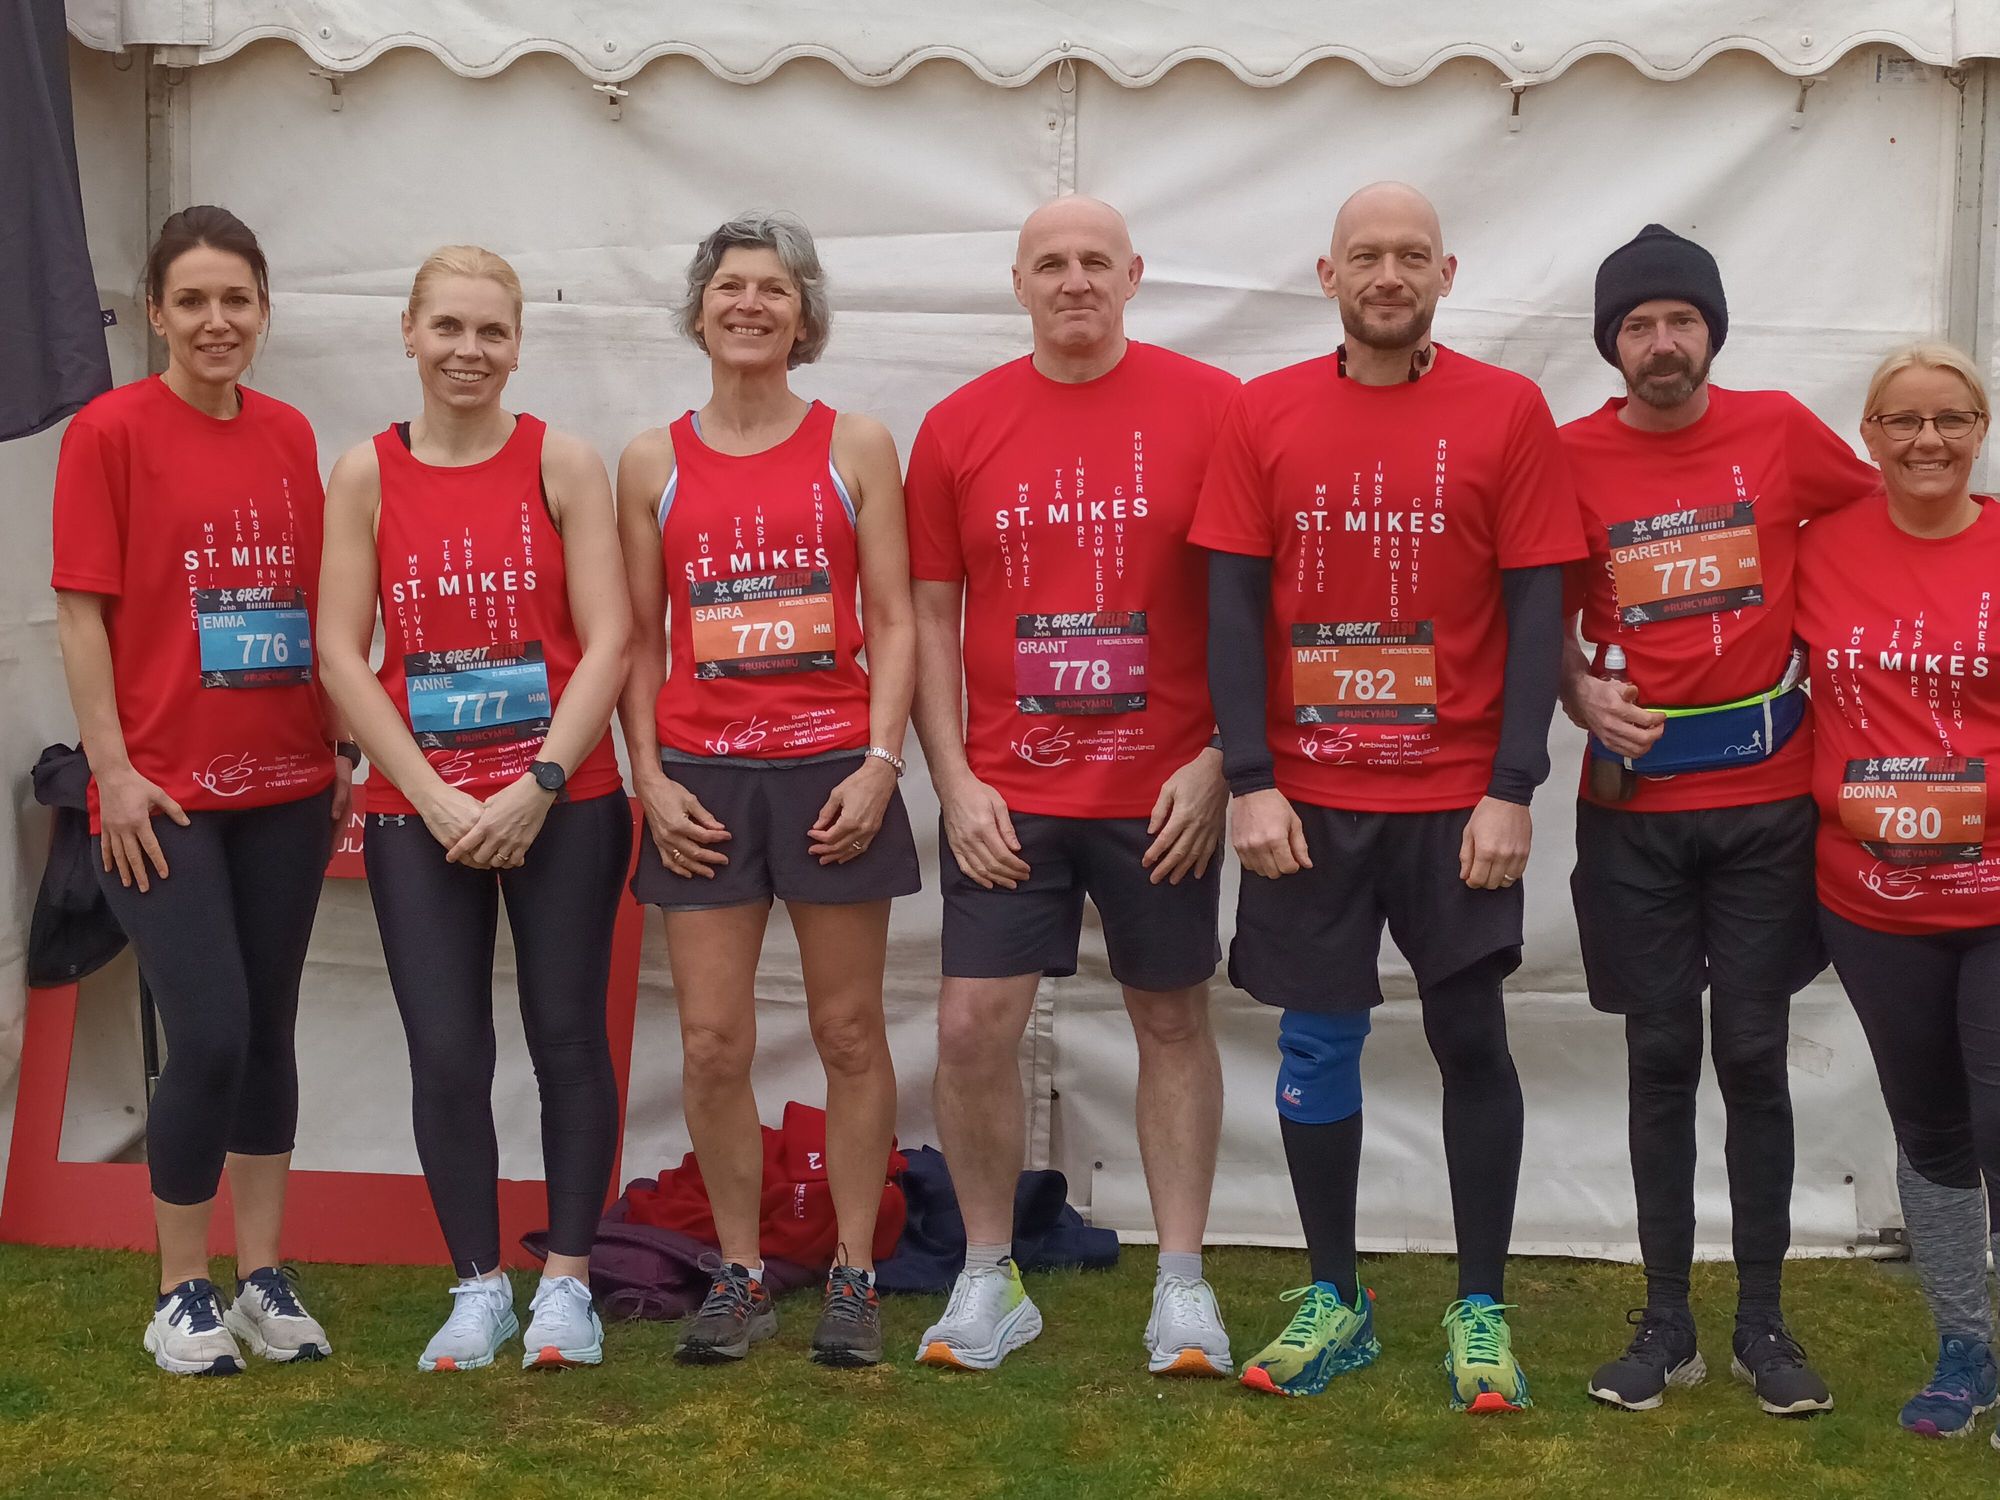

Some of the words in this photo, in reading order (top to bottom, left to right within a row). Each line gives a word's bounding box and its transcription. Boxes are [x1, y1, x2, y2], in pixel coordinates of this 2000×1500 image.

[995, 506, 1034, 531] ST.
[1048, 497, 1149, 525] MIKES
[1295, 511, 1332, 532] ST.
[1345, 511, 1447, 534] MIKES
[1651, 508, 1698, 530] GREAT
[184, 548, 220, 571] ST.
[1615, 540, 1682, 564] GARETH
[685, 557, 717, 582] ST.
[730, 547, 830, 574] MIKES
[1387, 511, 1404, 621] KNOWLEDG
[1738, 556, 1757, 570] HM
[1653, 554, 1721, 595] 775
[392, 579, 426, 603] ST.
[438, 570, 537, 596] MIKES
[732, 575, 778, 594] GREAT
[236, 586, 274, 603] GREAT
[503, 557, 518, 645] CENTUR
[407, 555, 425, 653] MOTIVAT
[203, 614, 247, 630] EMMA
[695, 605, 744, 622] SAIRA
[1052, 612, 1097, 629] GREAT
[731, 619, 796, 655] 779
[813, 624, 831, 635] HM
[1336, 621, 1382, 638] GREAT
[237, 633, 289, 665] 776
[445, 646, 490, 665] GREAT
[1018, 640, 1068, 655] GRANT
[1297, 649, 1340, 664] MATT
[1826, 648, 1864, 670] ST.
[1879, 651, 1989, 678] MIKES
[1050, 659, 1112, 691] 778
[1129, 665, 1145, 676] HM
[412, 676, 454, 692] ANNE
[1333, 668, 1397, 701] 782
[1415, 676, 1433, 687] HM
[528, 693, 546, 704] HM
[447, 690, 509, 726] 777
[810, 708, 836, 718] WALES
[1117, 728, 1144, 736] WALES
[1402, 733, 1431, 741] WALES
[783, 737, 813, 749] CYMRU
[1085, 754, 1114, 762] CYMRU
[1882, 757, 1930, 773] GREAT
[489, 767, 522, 779] CYMRU
[1843, 785, 1898, 800] DONNA
[1875, 806, 1943, 840] 780
[1962, 815, 1982, 826] HM
[1977, 858, 2000, 868] WALE
[1942, 887, 1977, 896] CYMRU
[1284, 1083, 1302, 1097] LP
